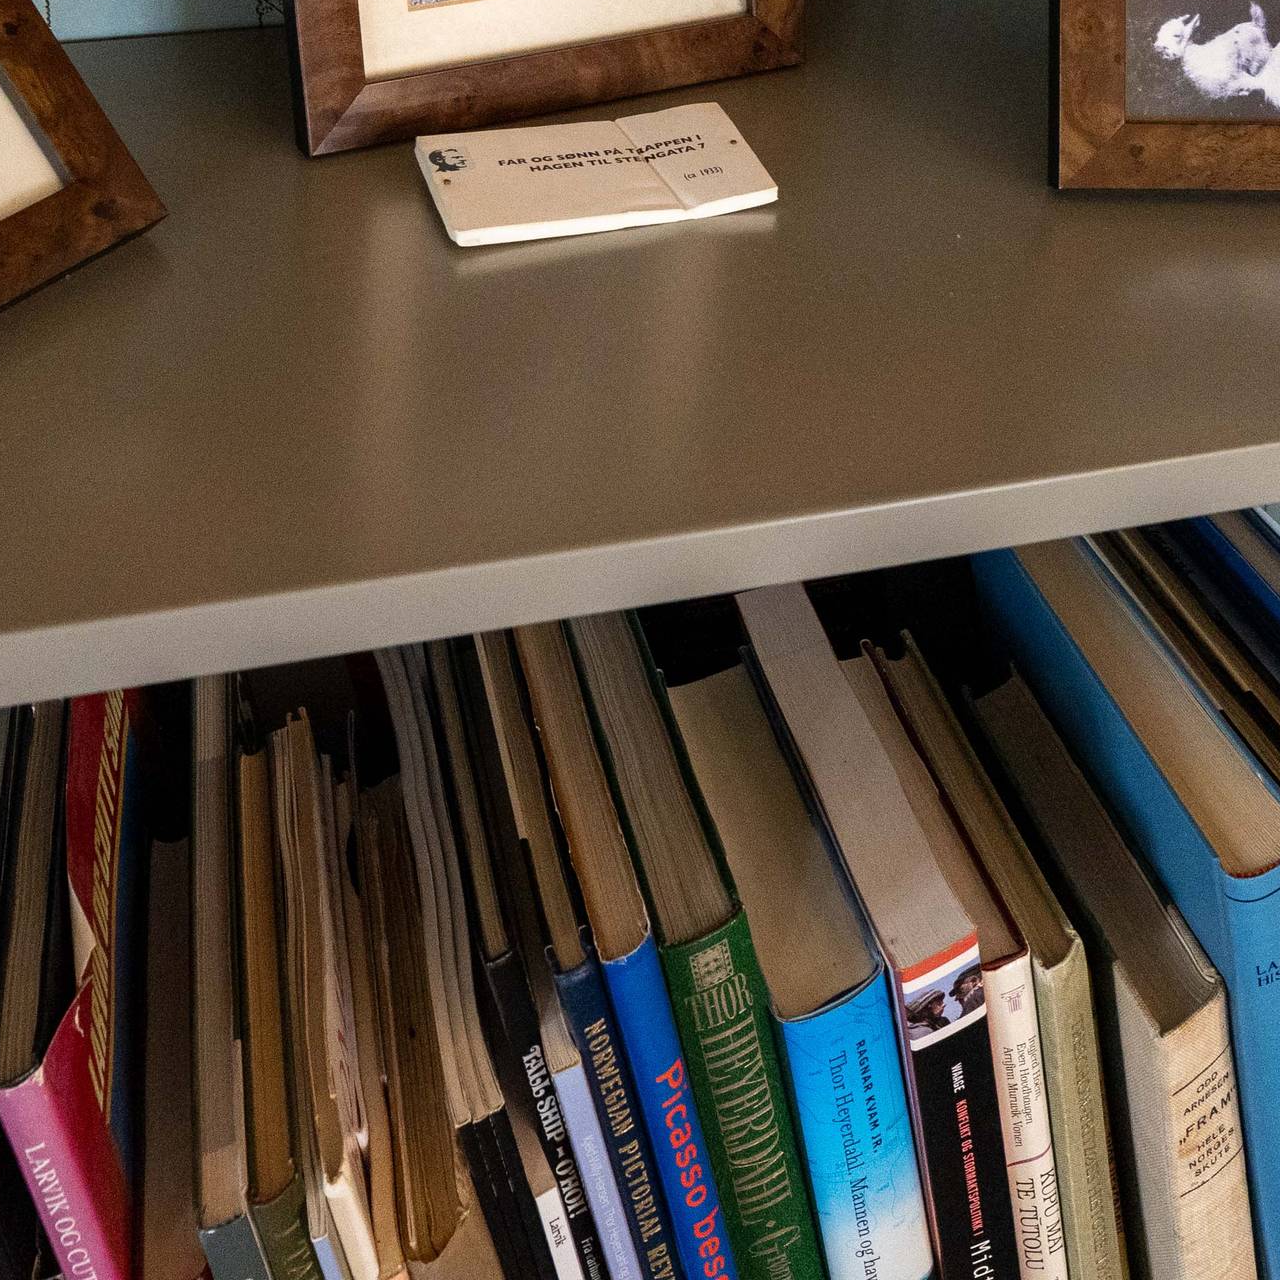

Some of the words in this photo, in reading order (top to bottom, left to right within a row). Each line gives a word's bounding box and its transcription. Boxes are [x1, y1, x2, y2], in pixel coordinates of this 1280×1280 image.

[498, 158, 527, 166] FAR
[531, 155, 553, 163] OG
[556, 150, 600, 161] SØNN
[604, 147, 623, 156] PÅ
[625, 136, 693, 155] TRAPPEN
[529, 160, 584, 172] HAGEN
[586, 158, 612, 166] TIL
[614, 145, 696, 164] STENGATA
[684, 972, 754, 1032] THOR
[829, 1049, 848, 1091] Thor
[855, 1038, 874, 1094] RAGNAR
[1016, 1042, 1026, 1067] Even
[522, 1044, 546, 1099] TALL
[536, 1095, 567, 1142] SHIP
[950, 1061, 966, 1094] WAAGE
[1002, 1046, 1017, 1080] Arnfinn
[1012, 1120, 1024, 1148] Vonen
[1183, 1071, 1230, 1116] ARNESEN
[1196, 1071, 1219, 1094] ODD
[583, 1018, 636, 1138] NORWEGIAN
[618, 1139, 663, 1243] PICTORIAL
[655, 1056, 708, 1208] Picasso
[699, 1009, 793, 1227] HEYERDAHL
[864, 1094, 881, 1132] KVAM
[955, 1098, 972, 1141] KONFLIKT
[871, 1131, 883, 1154] JR.
[961, 1139, 972, 1153] OG
[1188, 1127, 1235, 1170] NORGES
[1196, 1123, 1226, 1153] HELE
[1194, 1144, 1231, 1178] SKUTE
[24, 1142, 70, 1216] LARVIK
[55, 1217, 81, 1247] OG
[849, 1176, 872, 1238] Mannen
[1015, 1177, 1036, 1201] TE
[1040, 1168, 1059, 1219] KUPU
[548, 1216, 568, 1248] Larvik
[855, 1239, 874, 1258] og
[1046, 1219, 1064, 1255] MAI
